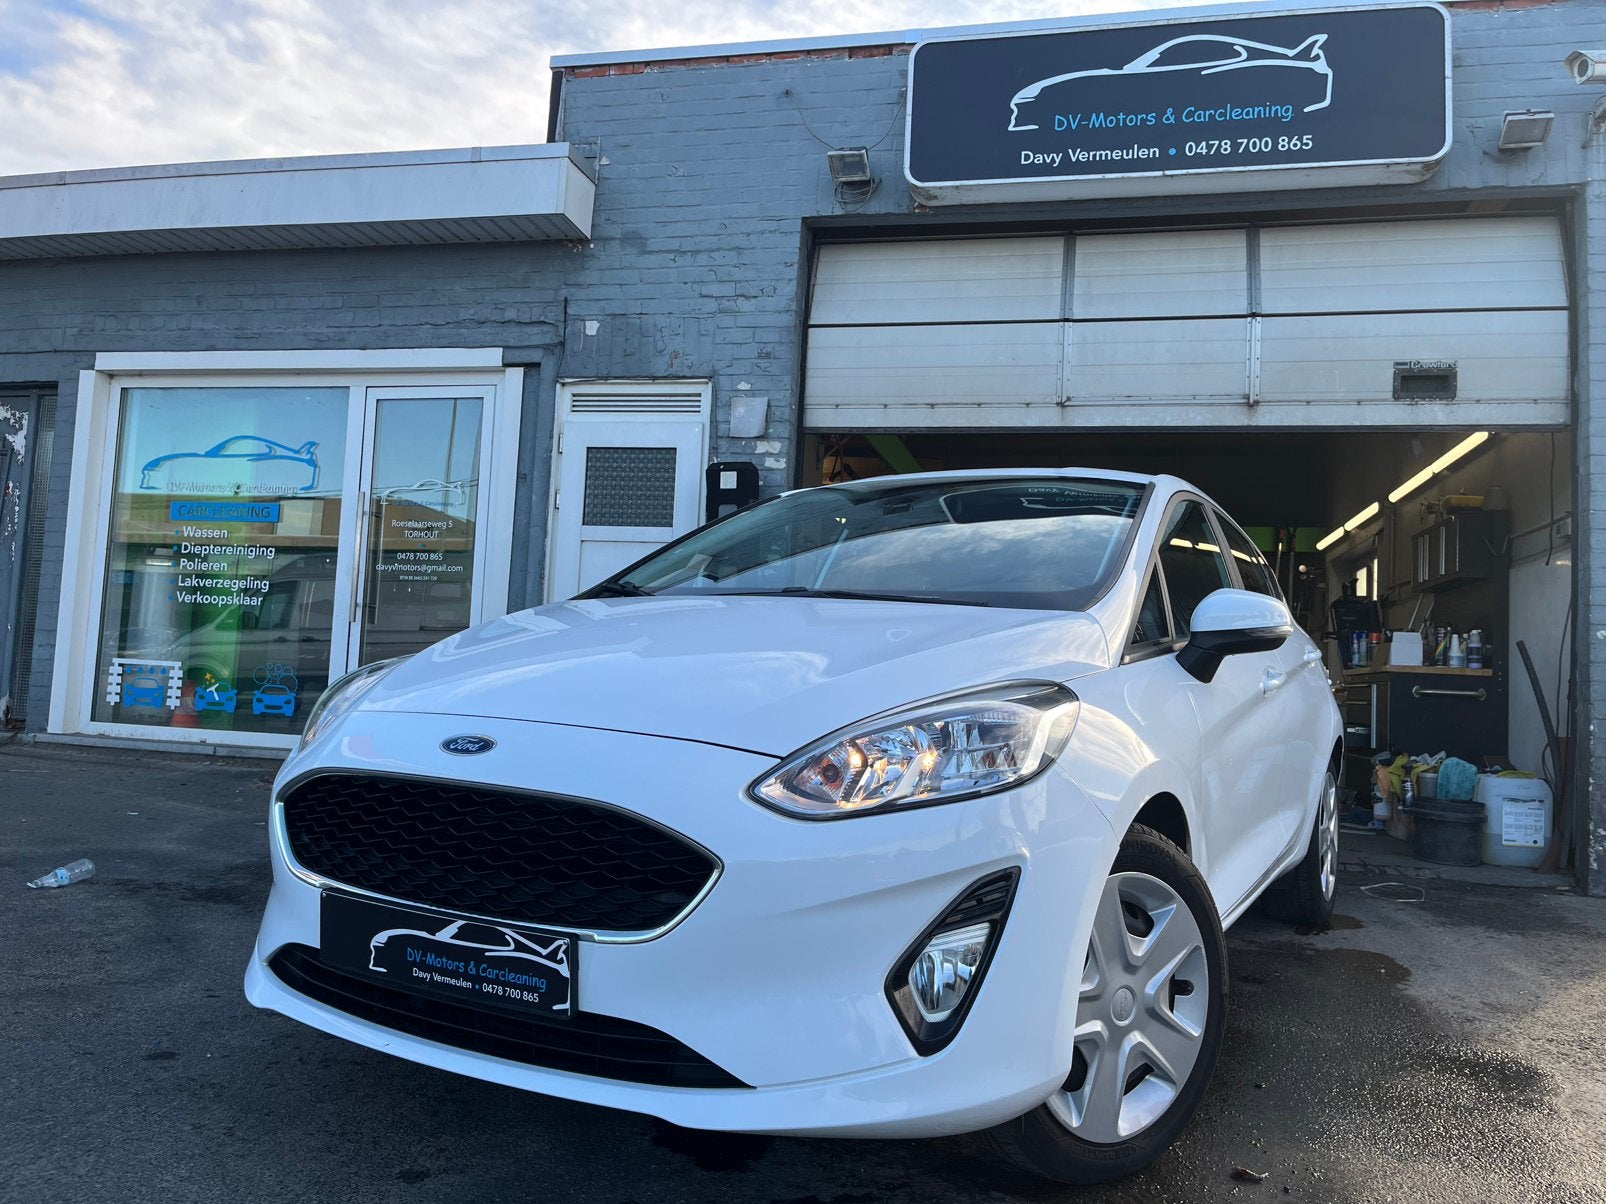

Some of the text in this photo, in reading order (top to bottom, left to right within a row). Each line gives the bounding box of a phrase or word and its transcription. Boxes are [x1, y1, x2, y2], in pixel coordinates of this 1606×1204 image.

[1054, 102, 1293, 131] DV-Motors & Carcleaning
[1020, 134, 1313, 167] Davy Vermeulen 0478 700 865
[178, 503, 271, 519] CARCLEANING
[183, 526, 228, 538] Wassen
[391, 520, 447, 529] Roeselaarseweg
[404, 530, 439, 539] TORHOUT
[181, 542, 275, 559] Dieptereiniging
[396, 552, 443, 560] 0478 700 865
[180, 558, 228, 571] Polieren
[178, 575, 270, 592] Lakverzegeling
[176, 591, 263, 607] Verkoopsklaar
[450, 737, 484, 751] Ford
[406, 947, 547, 993] DV-Motors & Carcleaning
[412, 967, 539, 1003] Davy Vermeulen 0478 700 865
